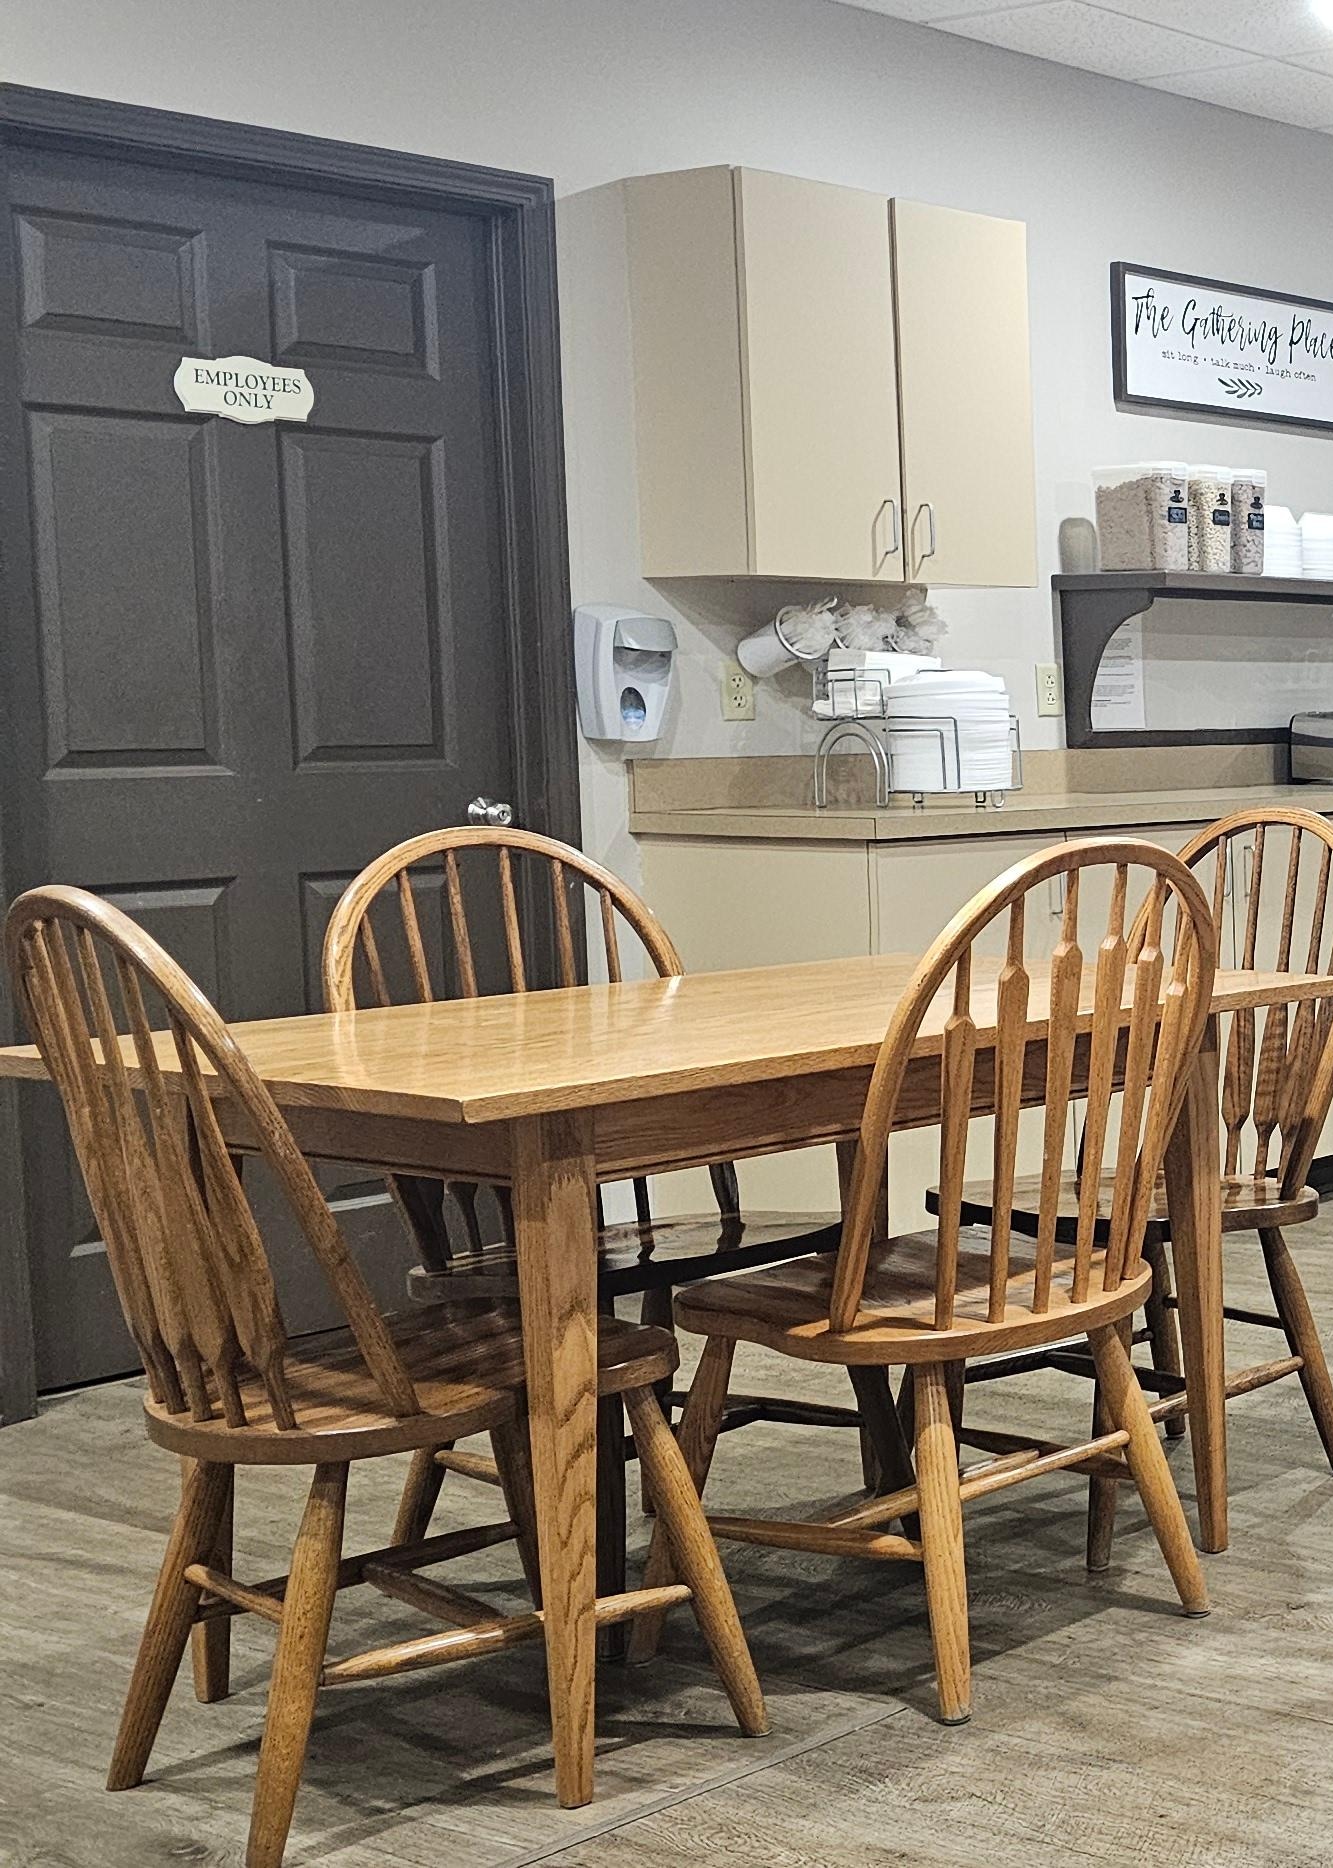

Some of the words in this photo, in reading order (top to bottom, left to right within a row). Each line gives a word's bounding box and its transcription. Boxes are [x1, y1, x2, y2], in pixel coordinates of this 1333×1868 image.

[1132, 288, 1174, 338] The
[1182, 299, 1283, 365] Gathering
[1161, 350, 1175, 360] sit
[1178, 351, 1199, 365] long
[1211, 358, 1230, 368] talk
[1233, 362, 1255, 372] much
[1265, 365, 1291, 379] laugh
[1294, 370, 1317, 381] often
[194, 368, 301, 394] EMPLOYEES
[223, 391, 274, 409] ONLY
